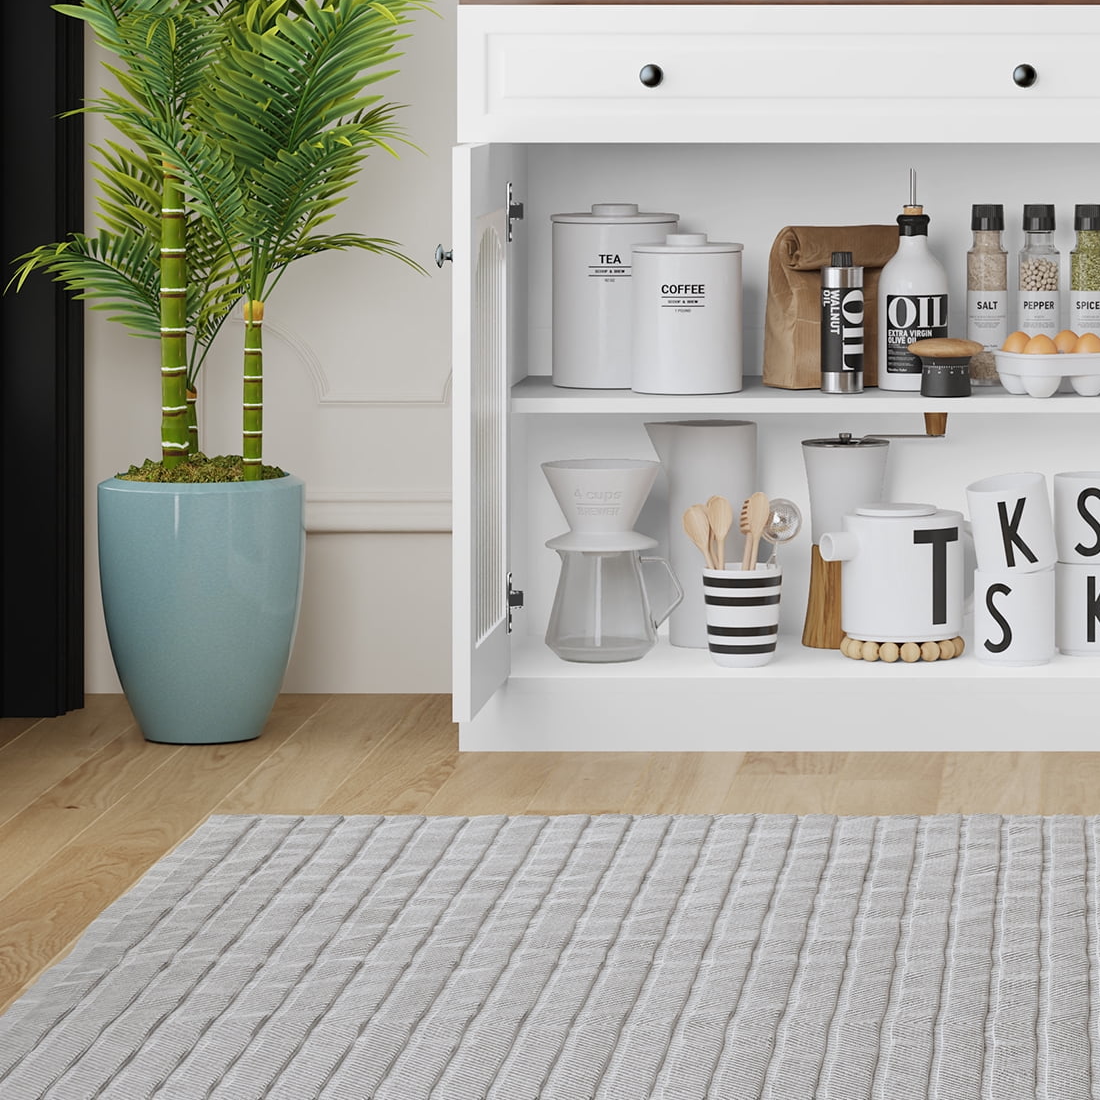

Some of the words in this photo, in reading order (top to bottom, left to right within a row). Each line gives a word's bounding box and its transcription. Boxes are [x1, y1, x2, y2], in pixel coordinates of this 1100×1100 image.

[598, 254, 622, 264] TEA
[661, 284, 705, 294] COFFEE
[830, 290, 840, 335] WALNUT
[888, 296, 948, 328] OIL
[976, 301, 998, 310] SALT
[1024, 301, 1055, 310] PEPPER
[842, 290, 864, 370] OIL
[888, 336, 906, 344] OLIVE
[574, 488, 582, 500] 4
[587, 490, 622, 502] cups
[997, 497, 1038, 568] K
[914, 526, 958, 624] T
[984, 583, 1012, 654] S
